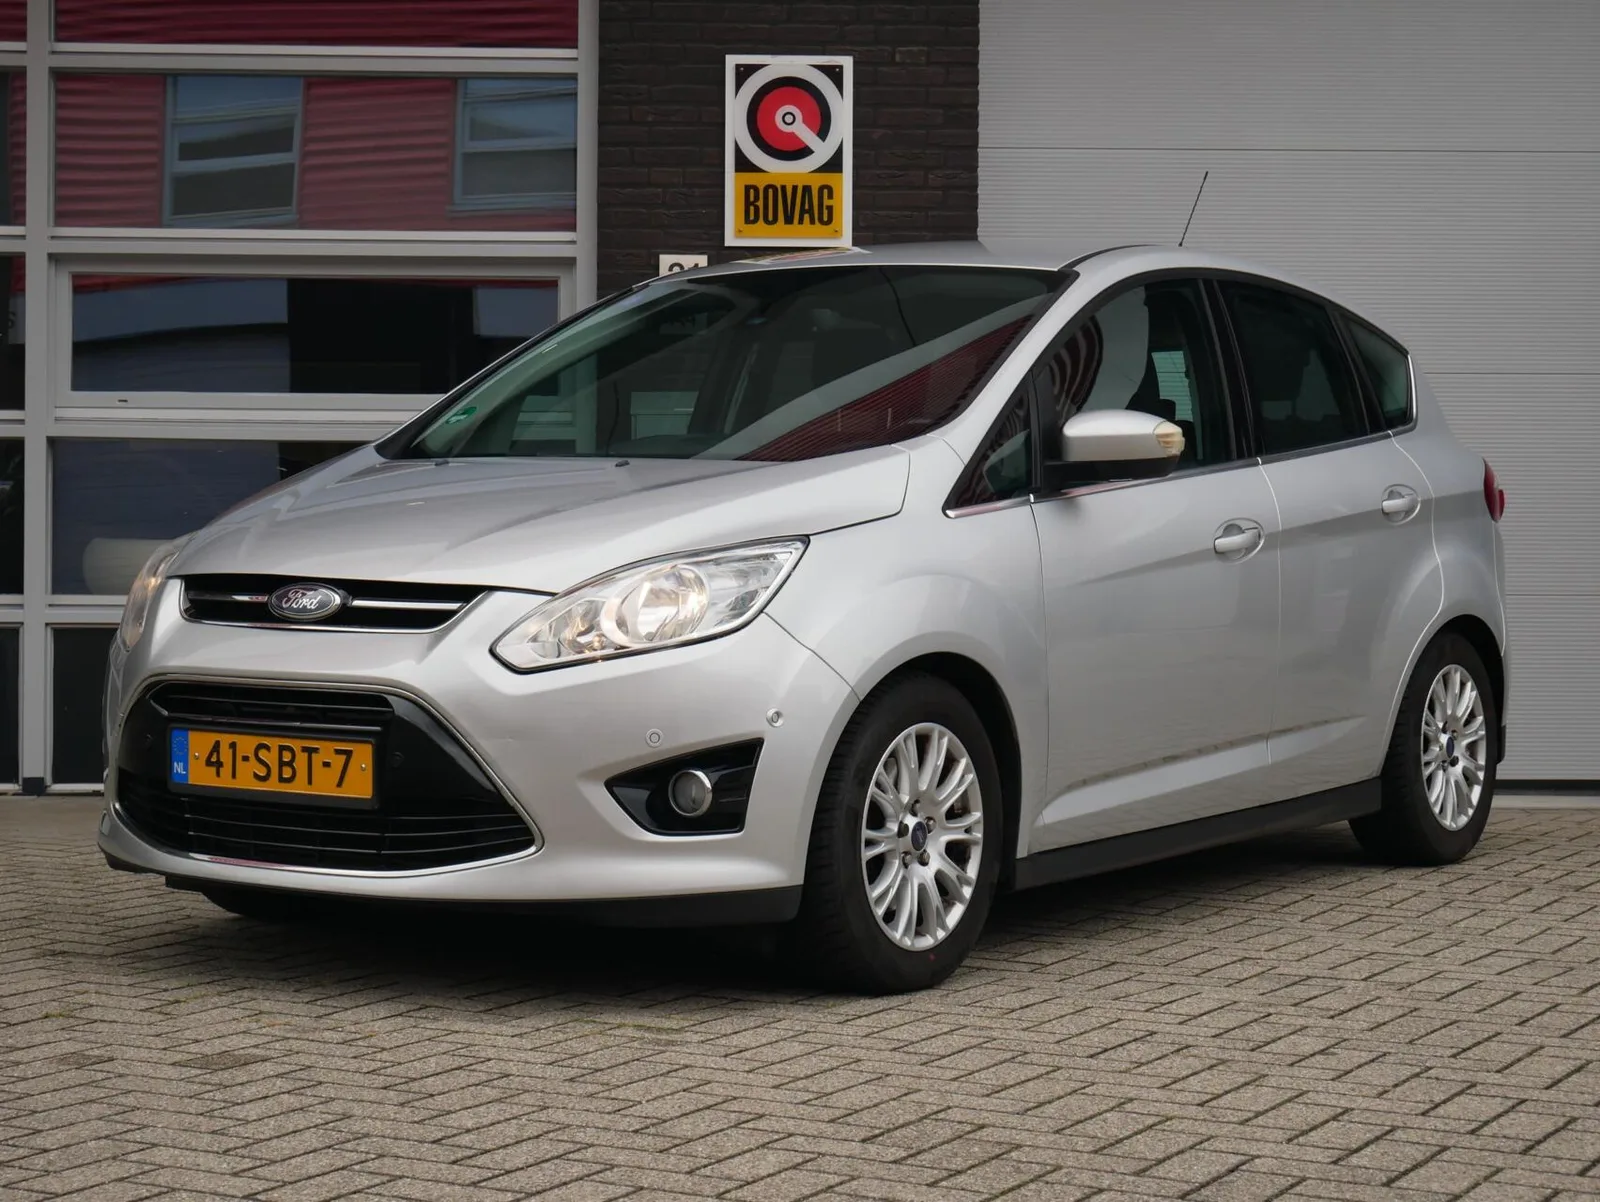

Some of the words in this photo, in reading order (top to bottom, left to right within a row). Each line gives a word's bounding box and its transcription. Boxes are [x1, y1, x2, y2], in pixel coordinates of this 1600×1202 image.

[744, 184, 834, 226] BOVAG
[281, 588, 322, 609] Ford
[173, 761, 187, 775] NL
[205, 739, 353, 788] 41-SBT-7
